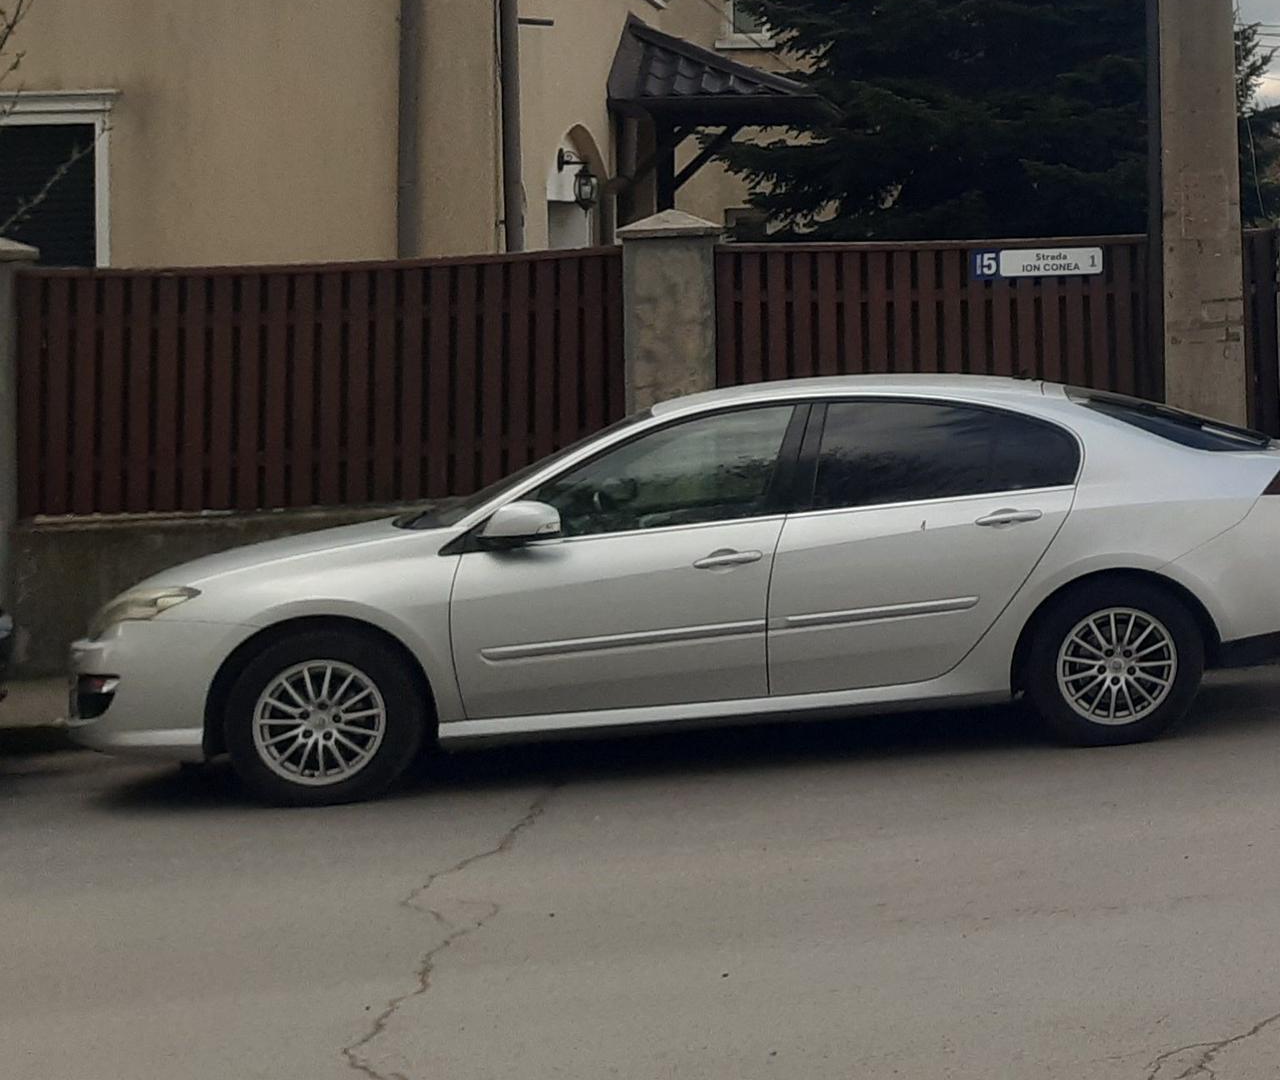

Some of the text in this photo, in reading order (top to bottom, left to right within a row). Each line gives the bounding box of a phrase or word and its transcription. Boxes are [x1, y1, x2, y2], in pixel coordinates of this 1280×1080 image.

[1035, 253, 1068, 261] Strada
[1089, 255, 1097, 267] 1
[1022, 263, 1080, 272] ION CONEA
